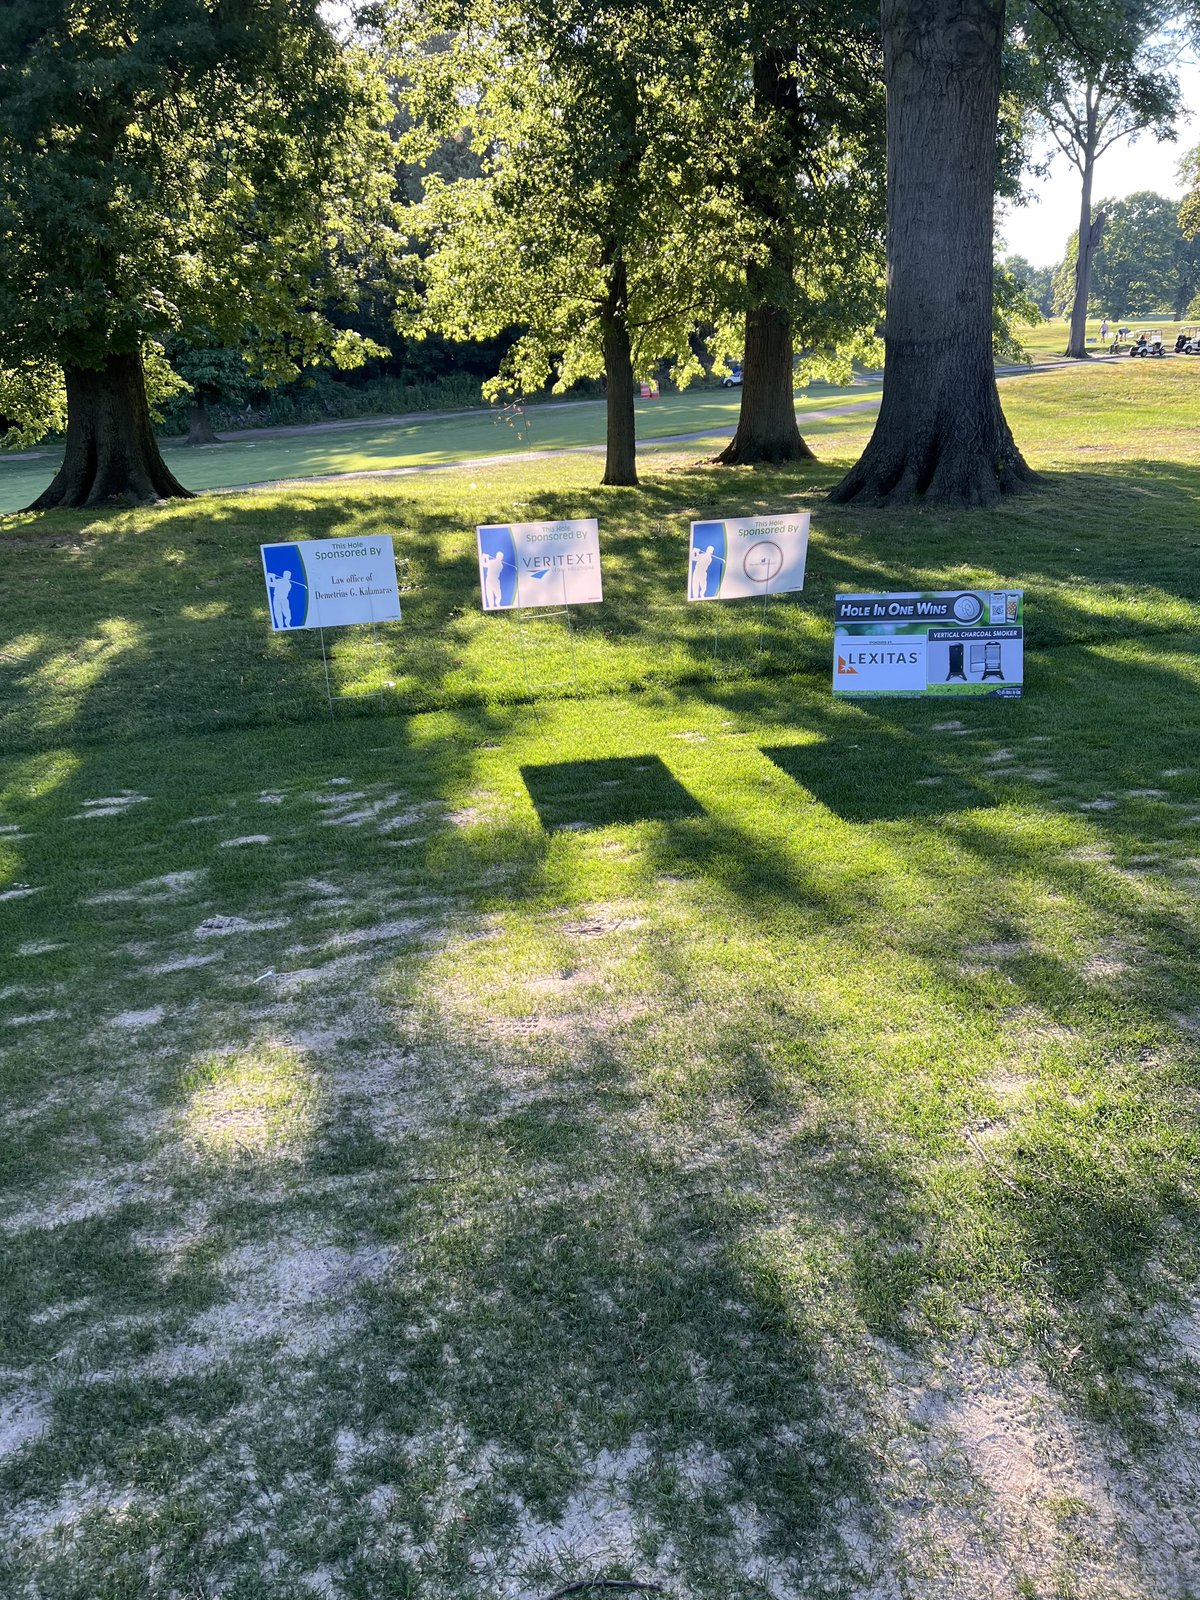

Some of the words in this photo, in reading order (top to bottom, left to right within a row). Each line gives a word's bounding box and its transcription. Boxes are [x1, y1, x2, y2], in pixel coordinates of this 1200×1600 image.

[526, 530, 574, 543] Sponsored
[576, 530, 588, 540] By
[738, 525, 785, 537] Sponsored
[788, 524, 799, 534] By
[347, 541, 364, 549] Hole
[315, 547, 367, 560] Sponsored
[370, 547, 382, 557] By
[522, 553, 594, 568] VERITEXT
[331, 575, 345, 585] Law
[346, 574, 364, 583] office
[365, 572, 373, 582] of
[359, 586, 392, 596] Kalamaras
[840, 603, 871, 617] HOLE
[873, 603, 886, 616] IN
[888, 602, 914, 616] ONE
[916, 602, 947, 615] WINS
[960, 630, 992, 638] CHARCOAL
[848, 652, 918, 665] LEXITAS
